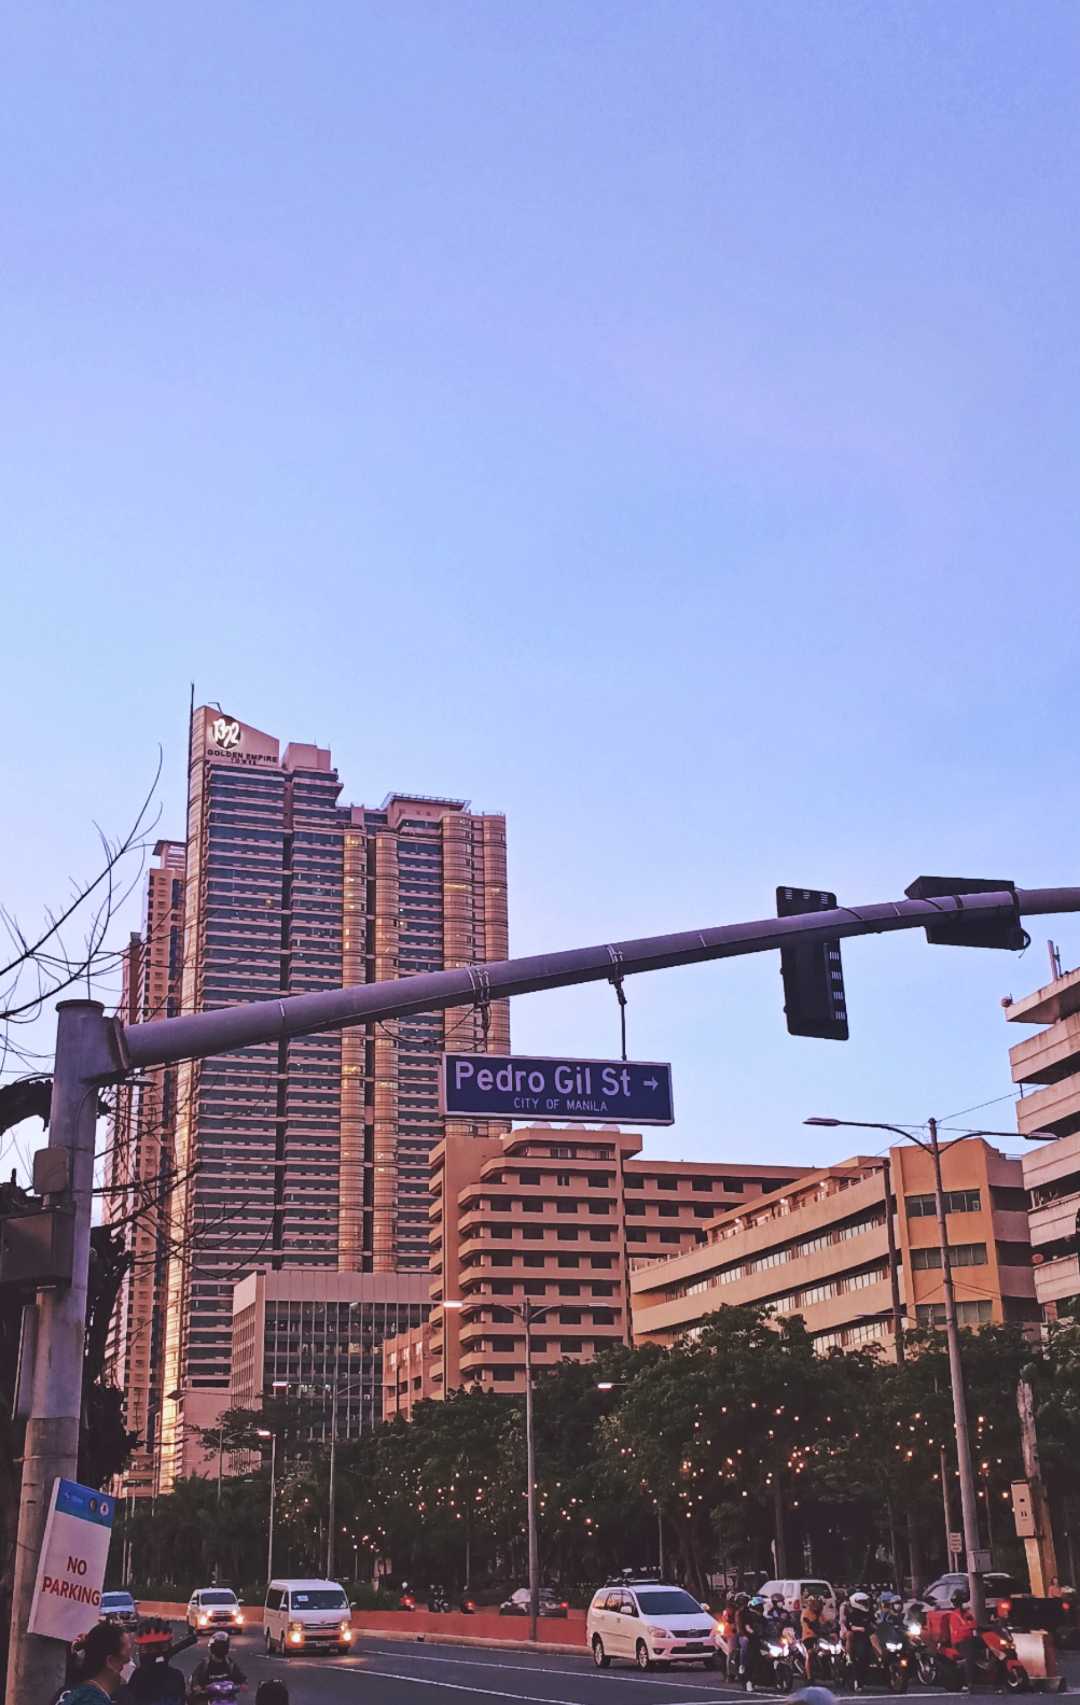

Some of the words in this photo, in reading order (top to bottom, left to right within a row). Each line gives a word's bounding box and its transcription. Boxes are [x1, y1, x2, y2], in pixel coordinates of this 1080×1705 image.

[207, 749, 243, 758] GOLDEN
[246, 753, 278, 763] EMPIRE
[455, 1061, 545, 1093] Pedro
[554, 1066, 592, 1095] Gil
[602, 1067, 631, 1096] St
[514, 1097, 540, 1109] CITY
[546, 1098, 560, 1110] OF
[567, 1100, 608, 1112] MANILA
[67, 1556, 87, 1575] NO
[41, 1576, 101, 1606] PARKING
